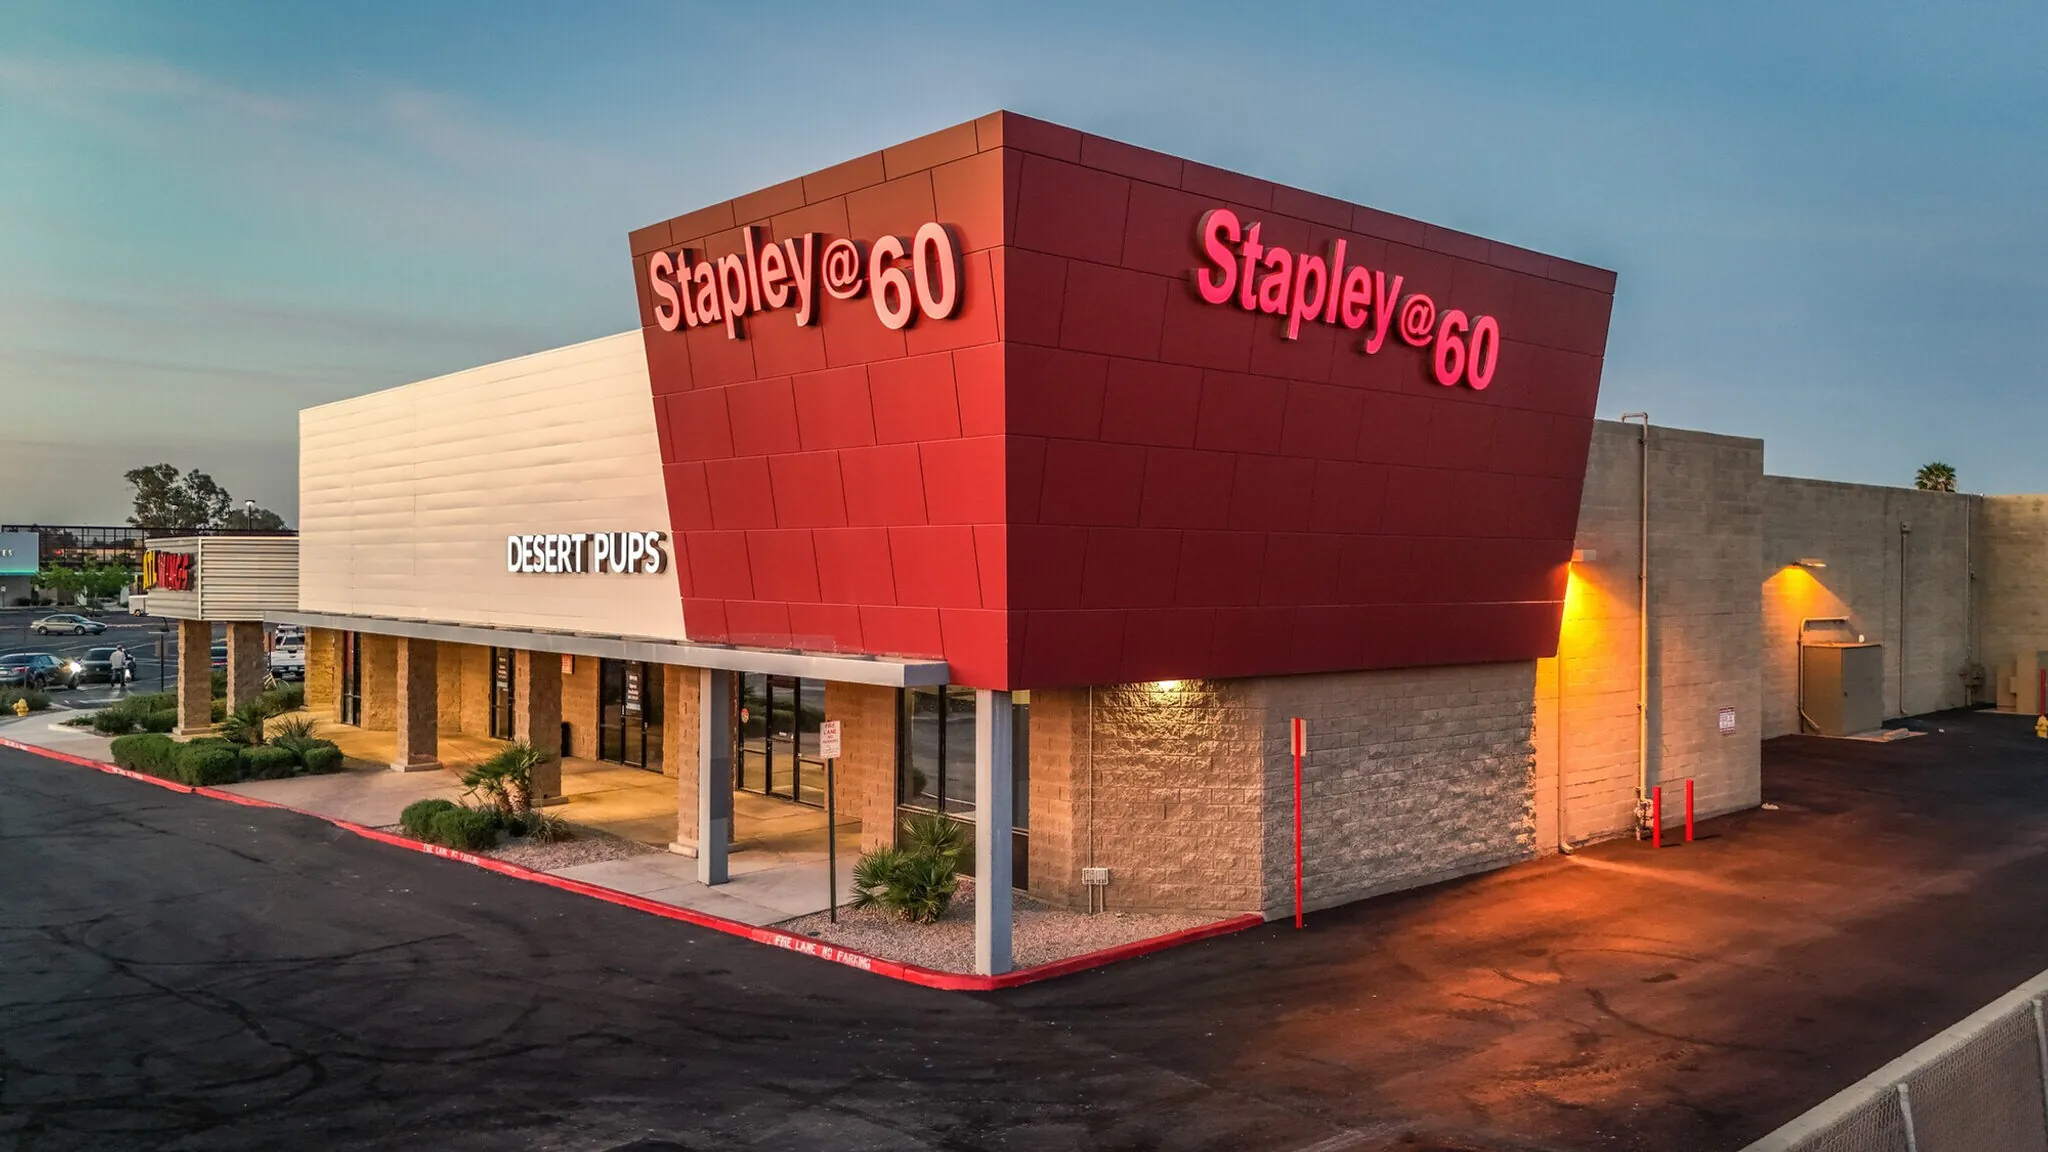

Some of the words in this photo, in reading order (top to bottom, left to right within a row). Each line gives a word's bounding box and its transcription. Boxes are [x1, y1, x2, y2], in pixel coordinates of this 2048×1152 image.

[507, 533, 588, 573] DESERT
[594, 531, 665, 574] PUPS
[775, 934, 792, 950] FIRE
[795, 941, 817, 955] LANE
[822, 945, 833, 958] NO
[837, 950, 871, 970] PARKING
